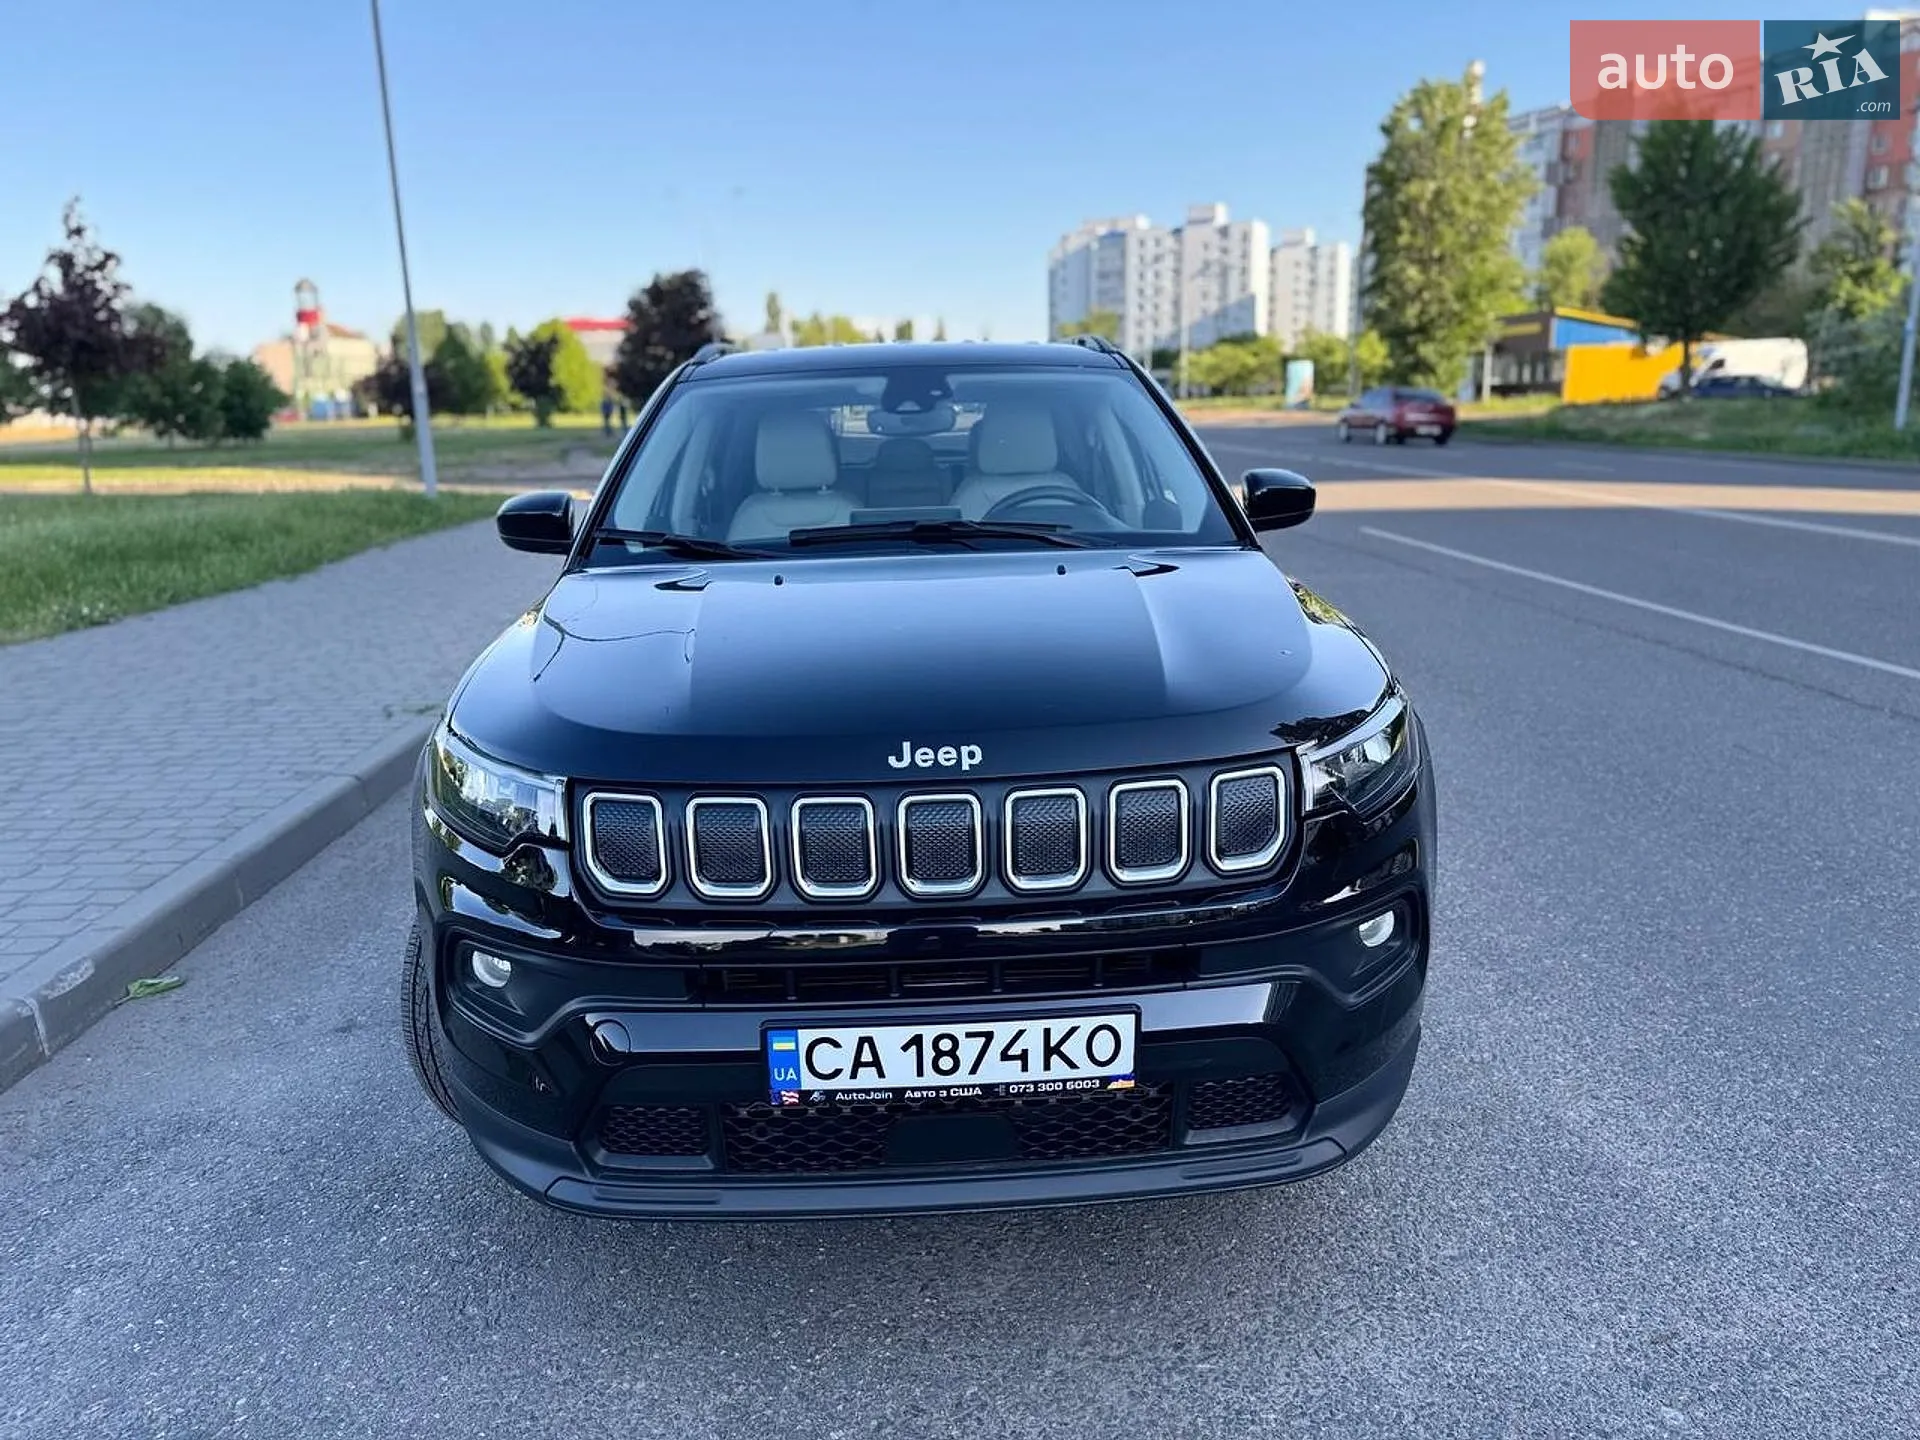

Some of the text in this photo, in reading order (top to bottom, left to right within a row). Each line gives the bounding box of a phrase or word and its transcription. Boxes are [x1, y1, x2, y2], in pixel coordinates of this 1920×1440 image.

[887, 741, 983, 771] Jeep
[805, 1023, 1122, 1081] CA 1874 KO
[774, 1067, 798, 1081] UA
[950, 1086, 983, 1097] США
[1009, 1083, 1035, 1093] 073
[1037, 1082, 1063, 1091] 300
[835, 1090, 893, 1101] AutoJoin
